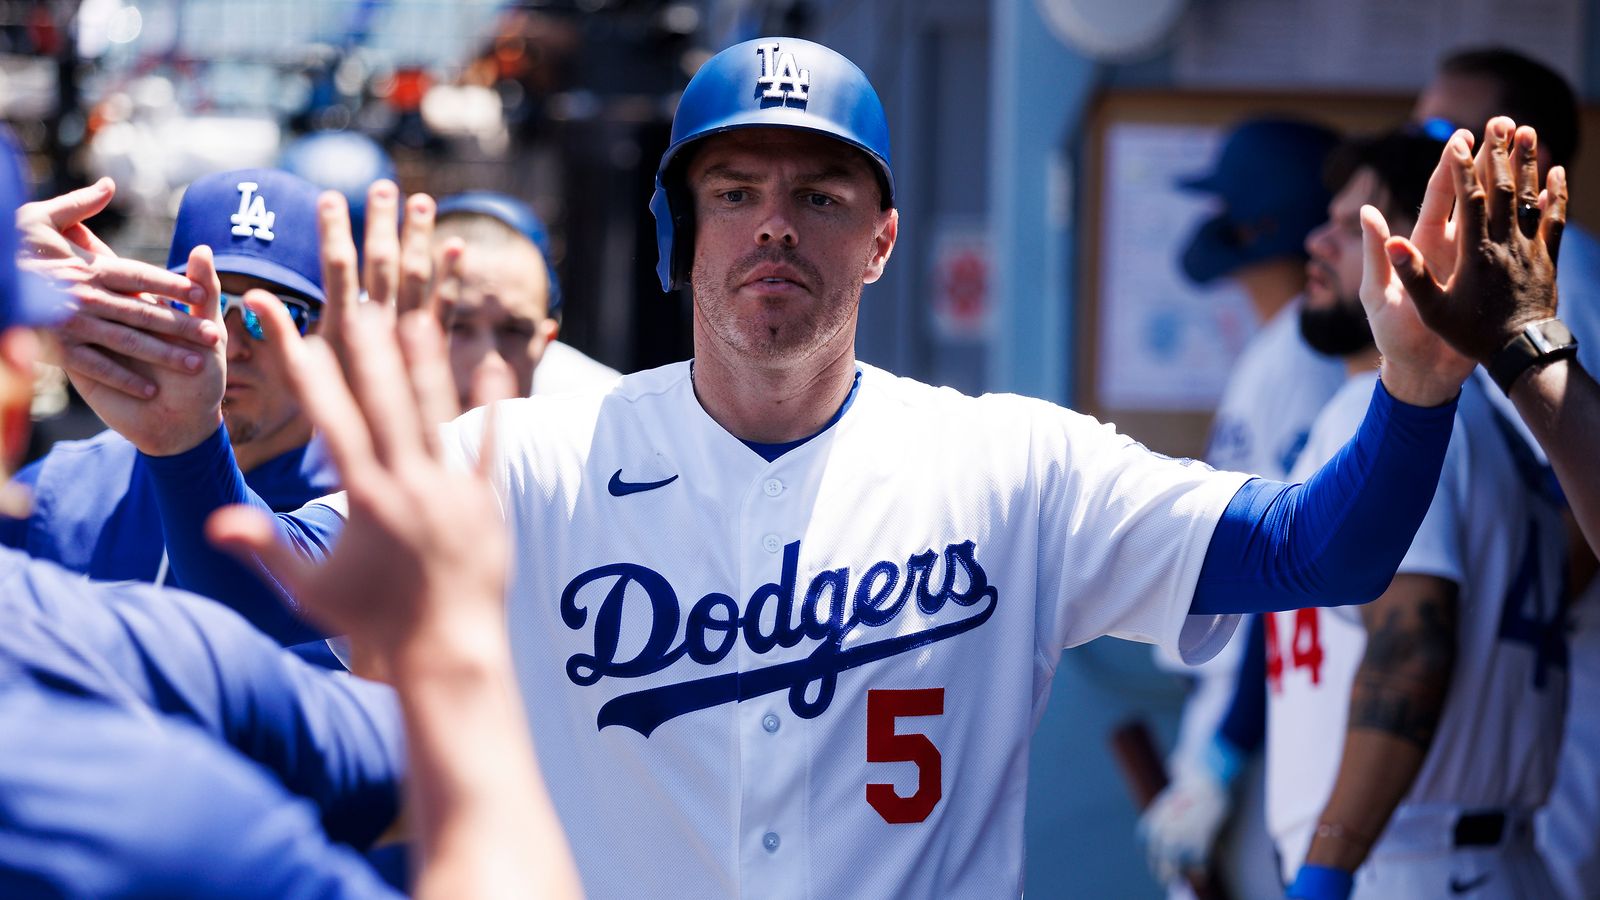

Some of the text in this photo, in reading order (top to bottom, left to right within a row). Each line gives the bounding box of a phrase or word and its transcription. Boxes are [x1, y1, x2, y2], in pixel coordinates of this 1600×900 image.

[756, 42, 810, 100] LA
[230, 182, 275, 241] LA
[561, 540, 998, 720] Dodgers
[866, 687, 944, 824] 5
